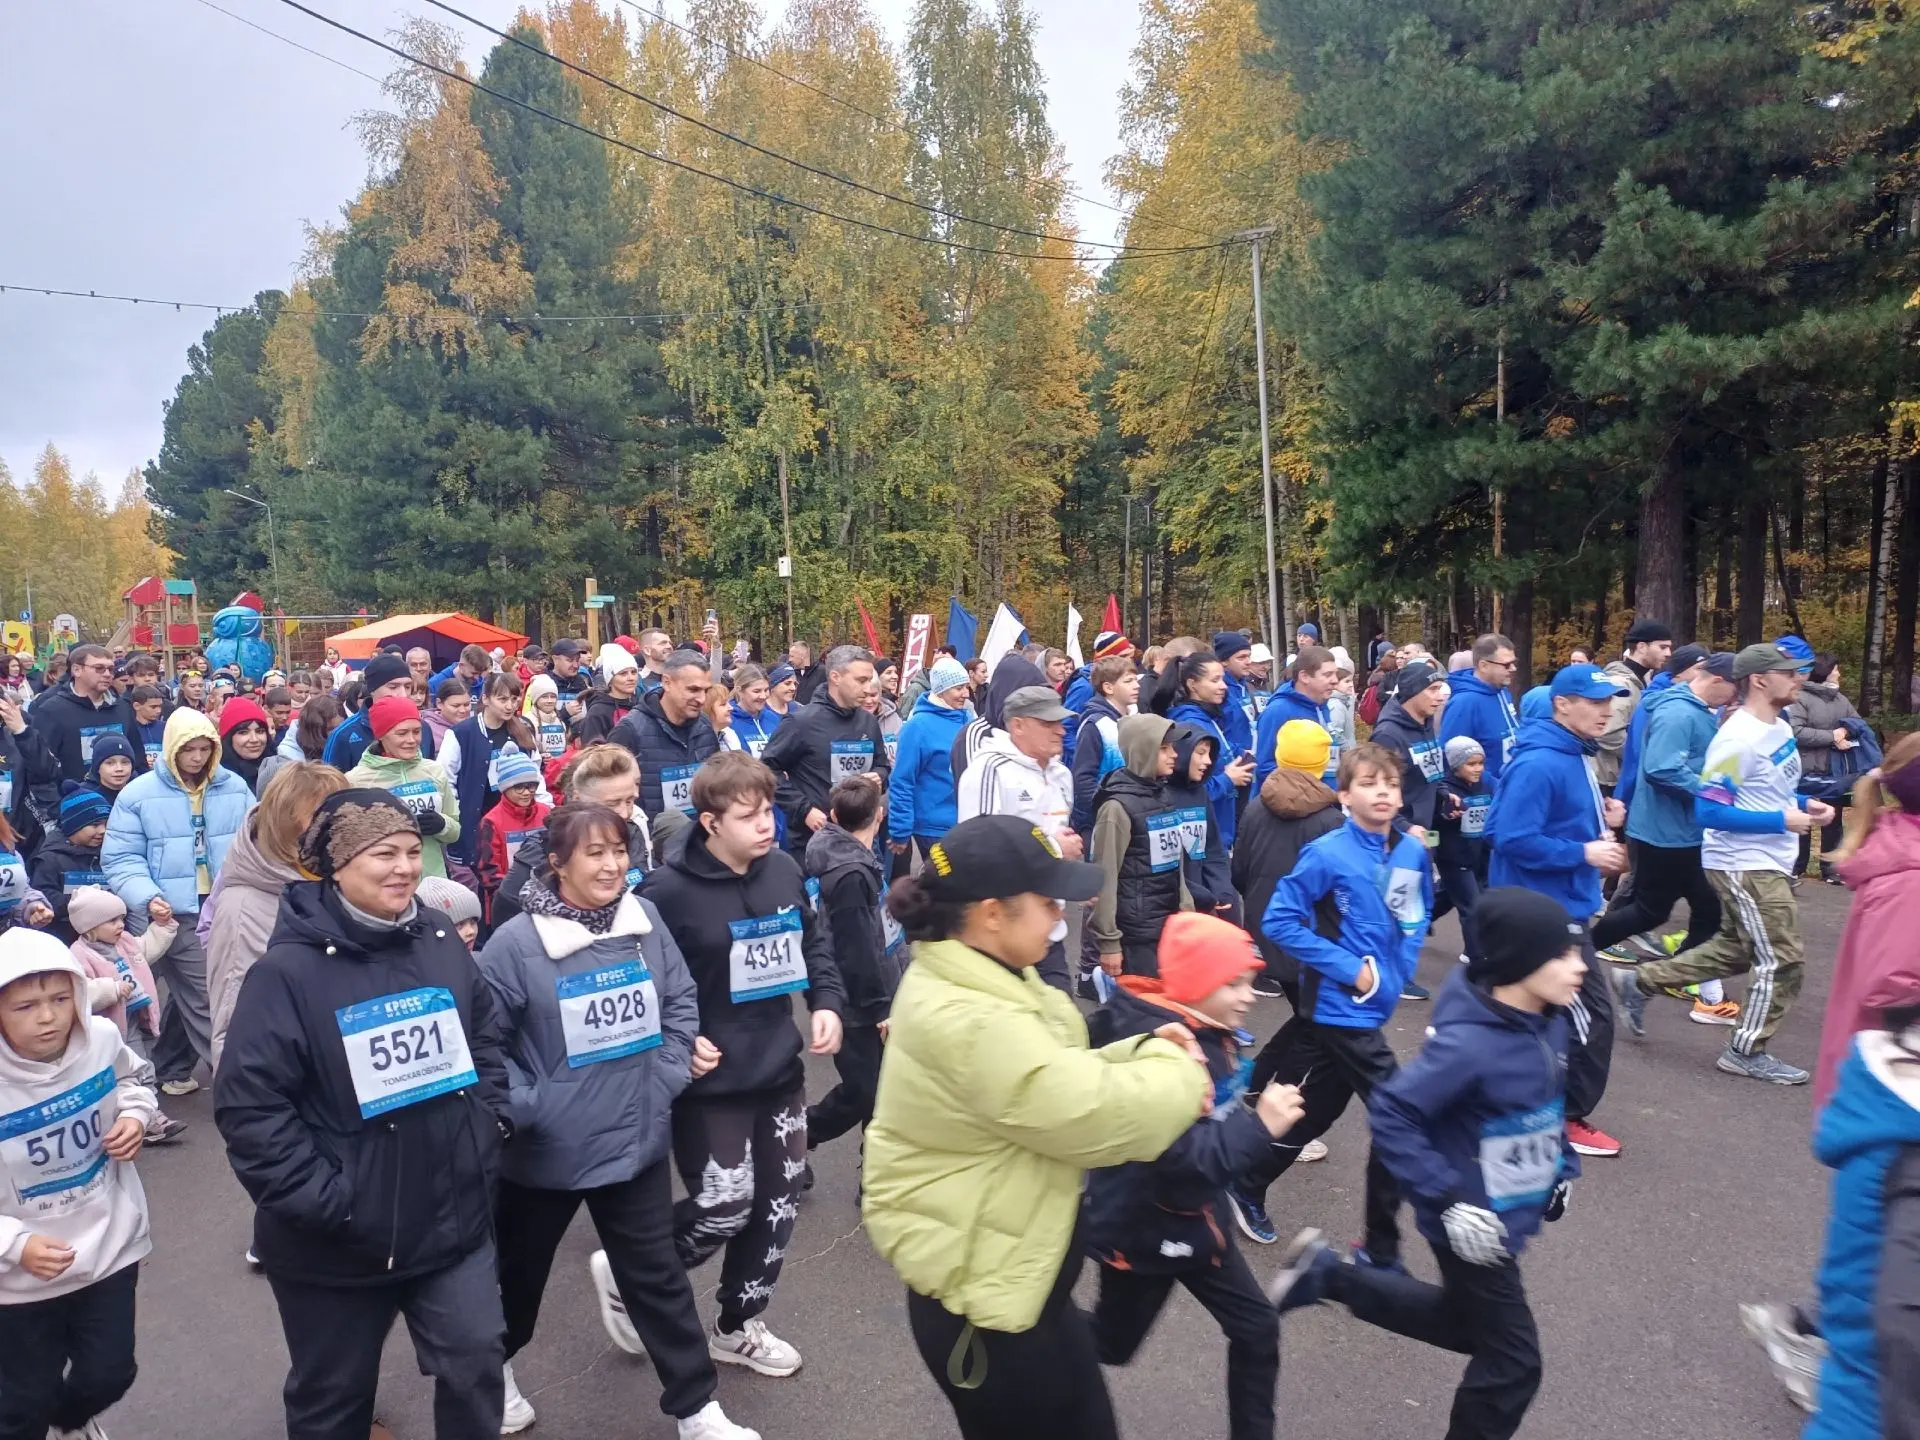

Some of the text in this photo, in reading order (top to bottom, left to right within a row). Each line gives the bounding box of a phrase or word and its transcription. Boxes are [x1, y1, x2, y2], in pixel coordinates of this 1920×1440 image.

[840, 756, 866, 771] 5659
[672, 782, 688, 800] 43
[408, 795, 436, 814] 894
[744, 938, 791, 970] 4341
[384, 996, 422, 1013] КРОСС
[584, 990, 646, 1029] 4928
[369, 1020, 444, 1071] 5521
[381, 1062, 453, 1086] ТОМСКАЯ ОБЛАСТЬ
[41, 1092, 83, 1116] КРОСС
[26, 1109, 102, 1167] 5700
